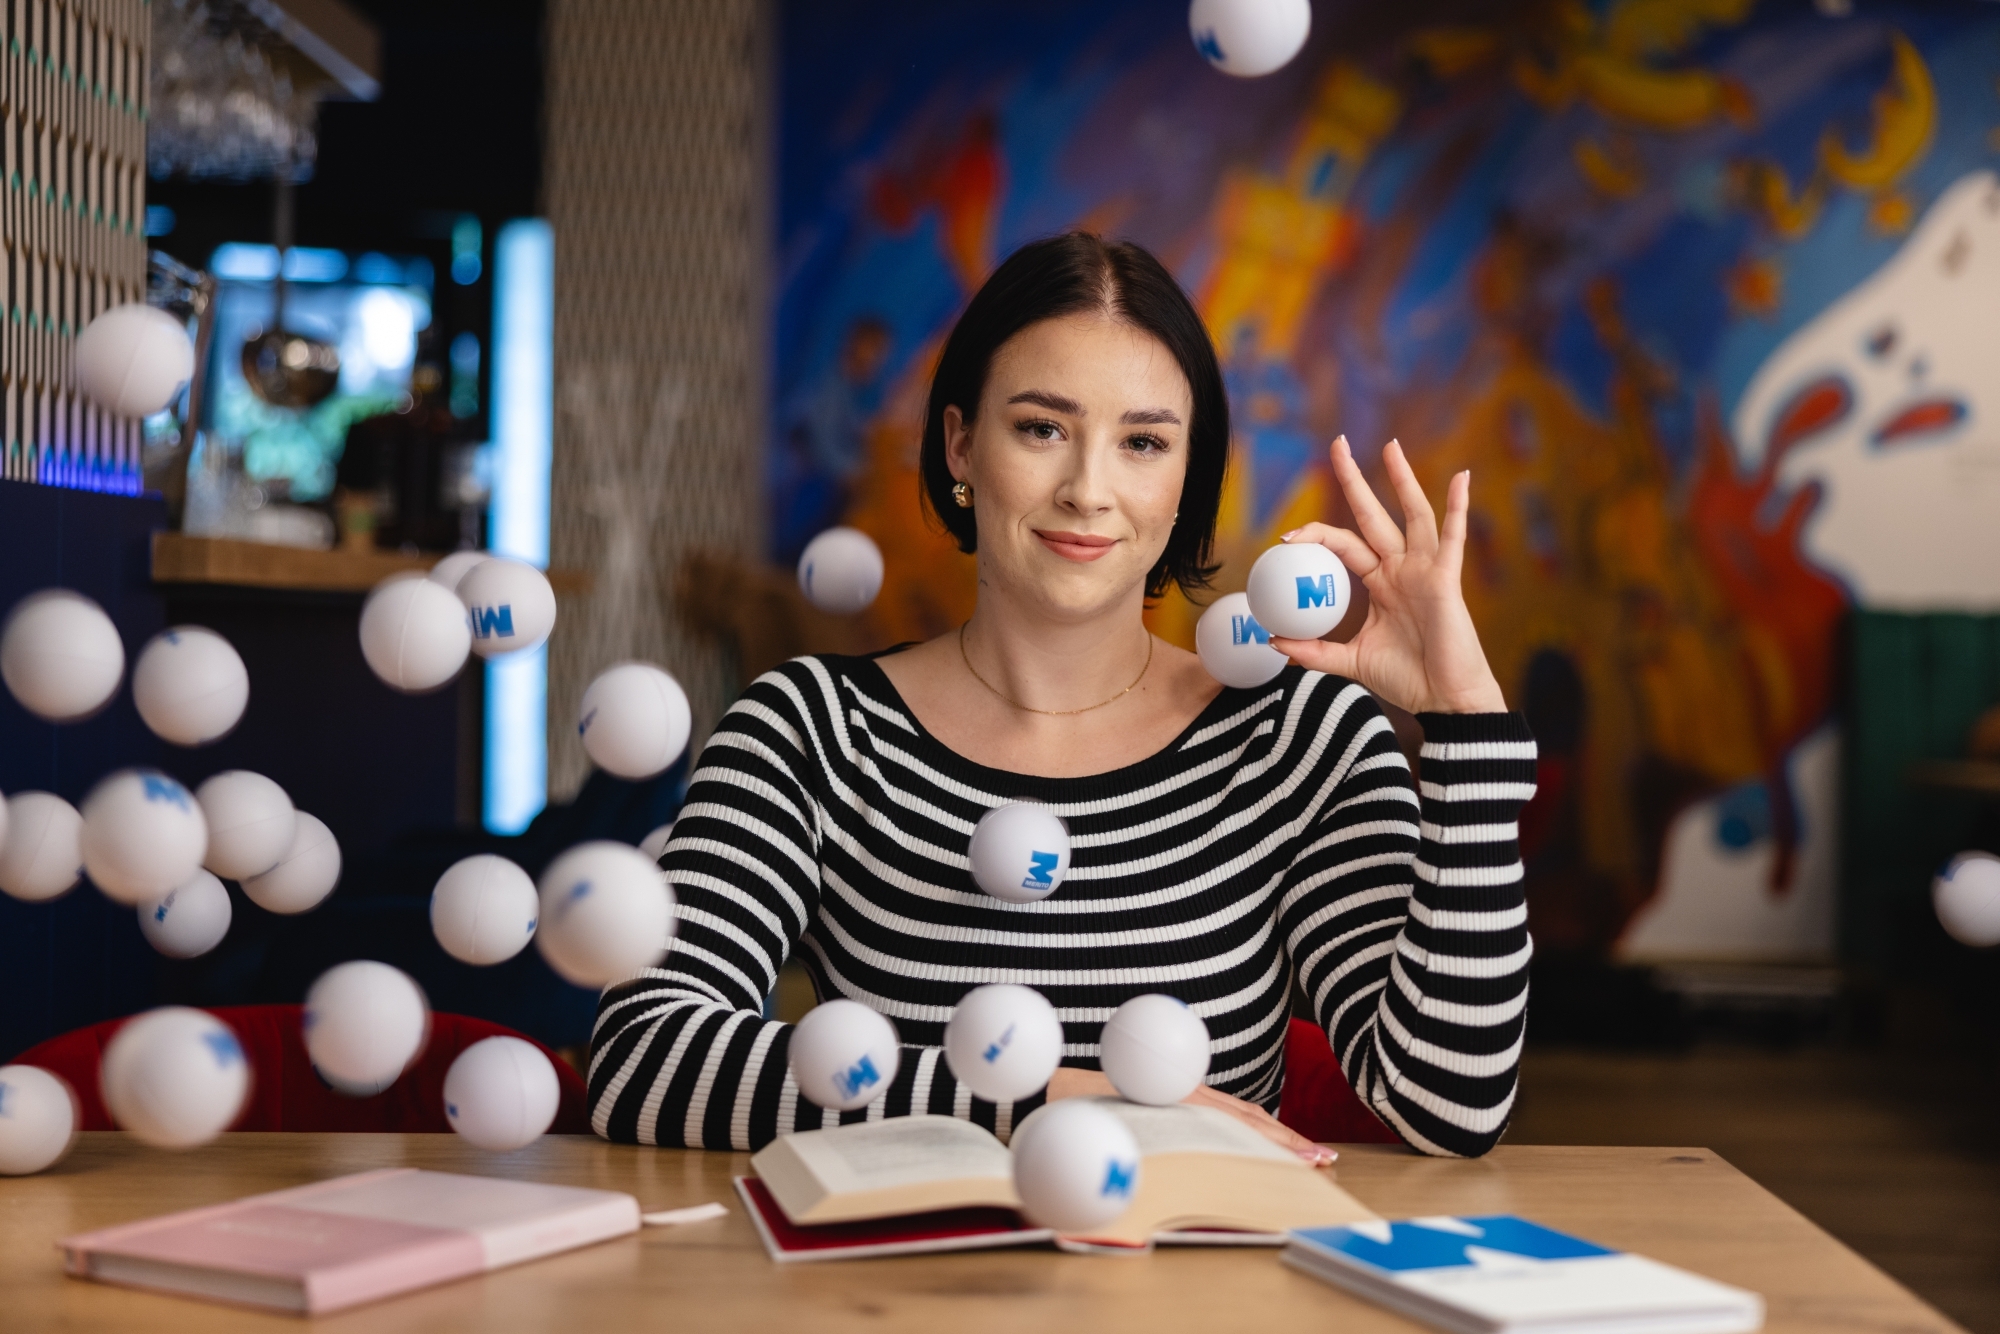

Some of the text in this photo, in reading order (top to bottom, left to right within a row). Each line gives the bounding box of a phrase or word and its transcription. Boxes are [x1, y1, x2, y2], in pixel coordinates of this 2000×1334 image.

[1295, 574, 1335, 609] M
[1326, 575, 1334, 605] MERITO
[1234, 616, 1242, 643] MERITO
[1021, 850, 1059, 890] M
[1024, 880, 1050, 889] MERITO
